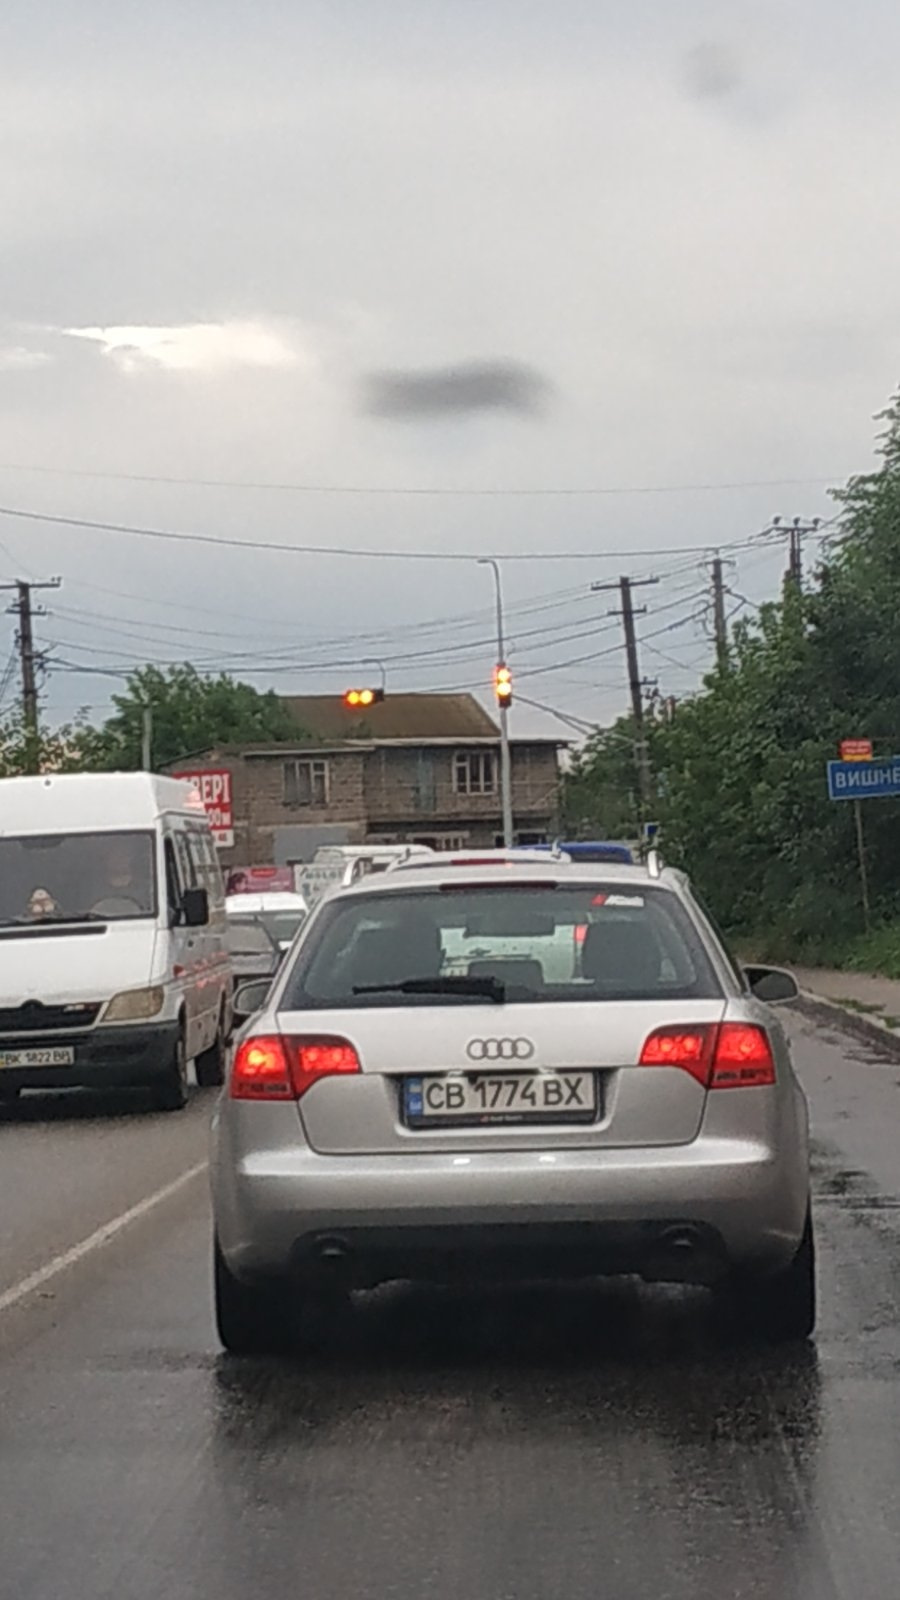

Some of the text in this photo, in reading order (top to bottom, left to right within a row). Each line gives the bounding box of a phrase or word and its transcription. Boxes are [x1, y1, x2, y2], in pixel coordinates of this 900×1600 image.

[835, 767, 900, 788] ВИШНЕ
[425, 1077, 584, 1109] CB 1774 BX
